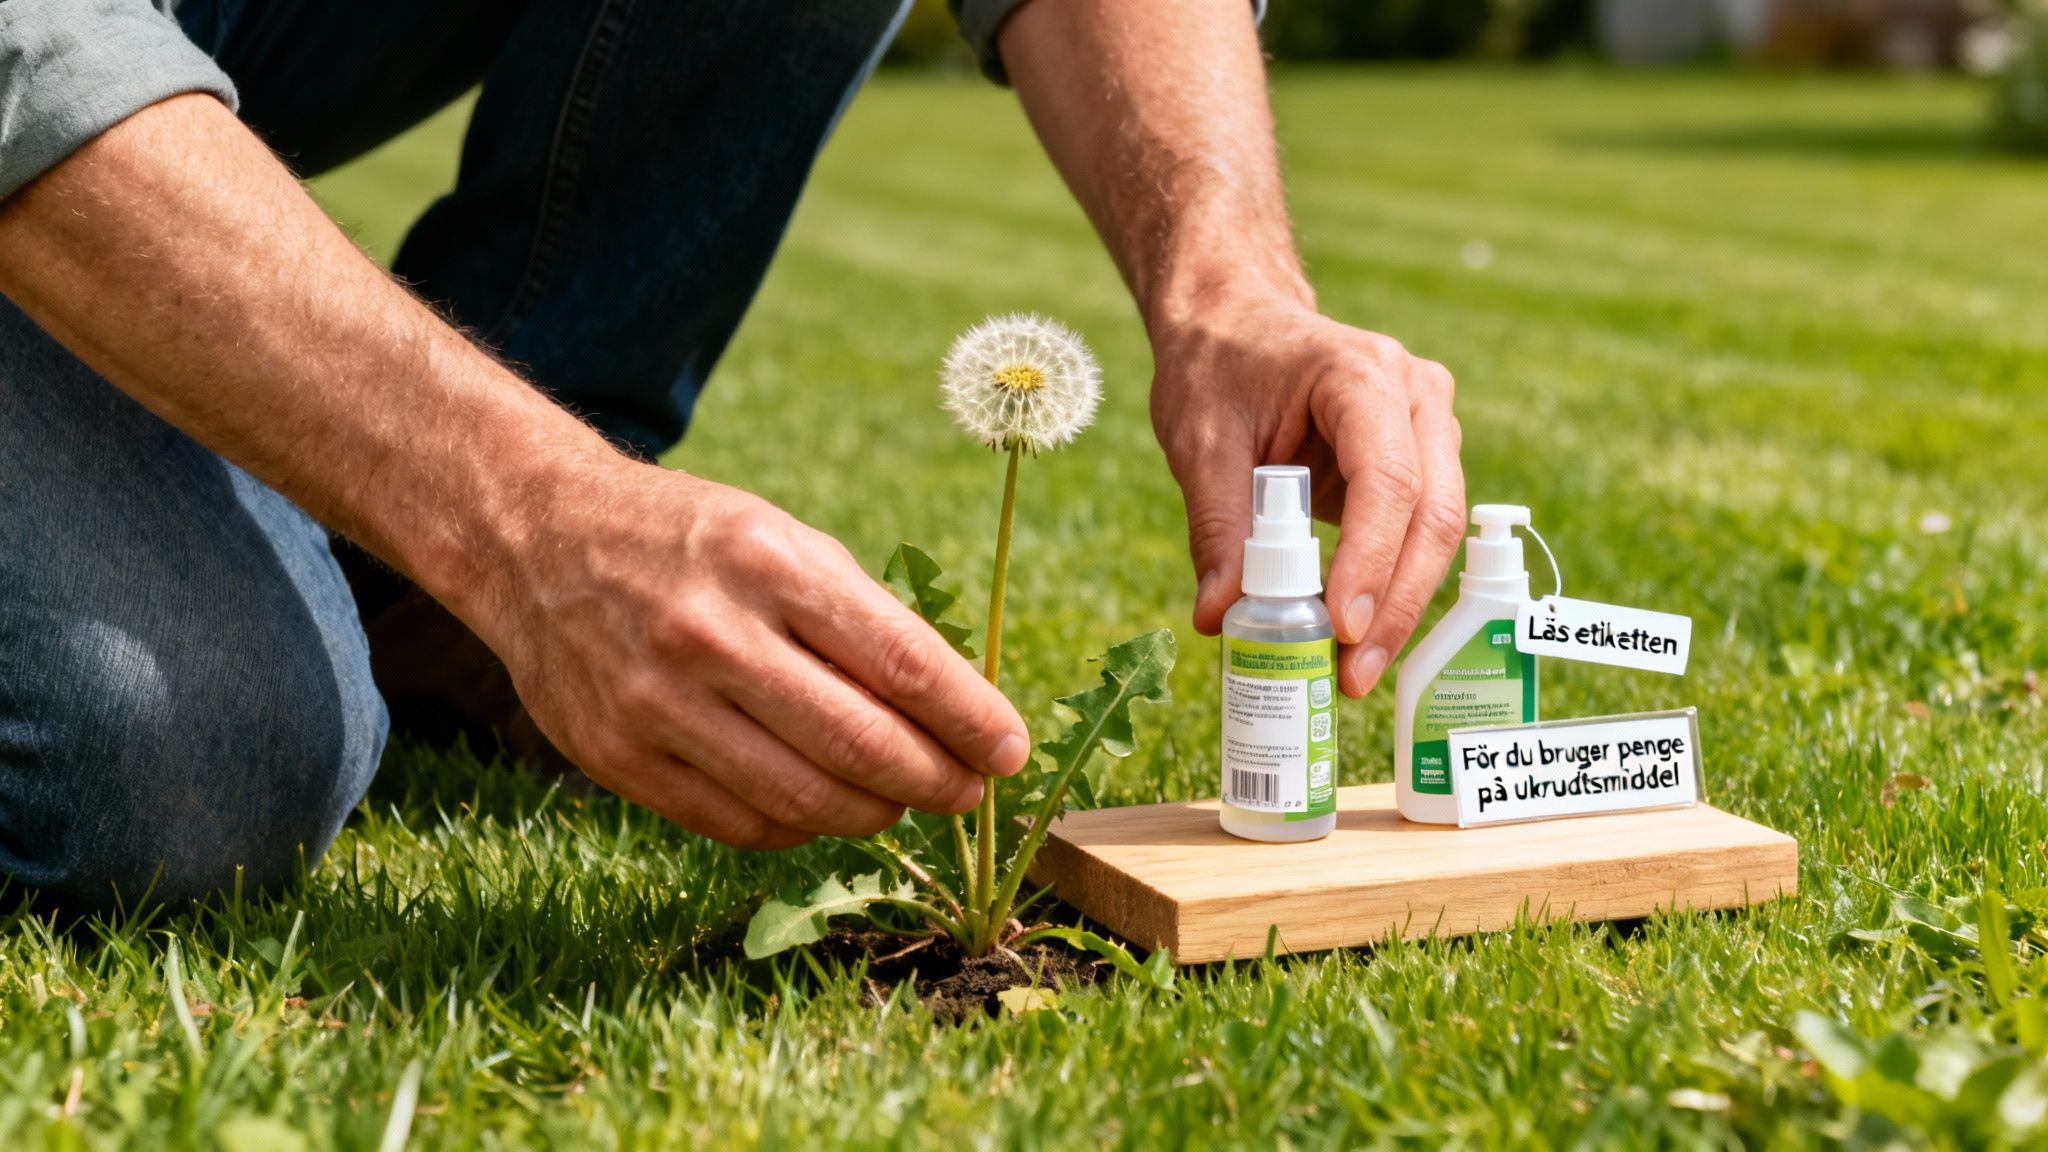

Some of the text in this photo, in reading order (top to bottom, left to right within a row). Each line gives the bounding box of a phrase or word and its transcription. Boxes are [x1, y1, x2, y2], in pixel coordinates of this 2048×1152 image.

[1528, 615, 1678, 656] Läs etiketten
[1462, 737, 1685, 771] För du bruger penge
[1478, 762, 1680, 813] på ukrudtsmiddel
